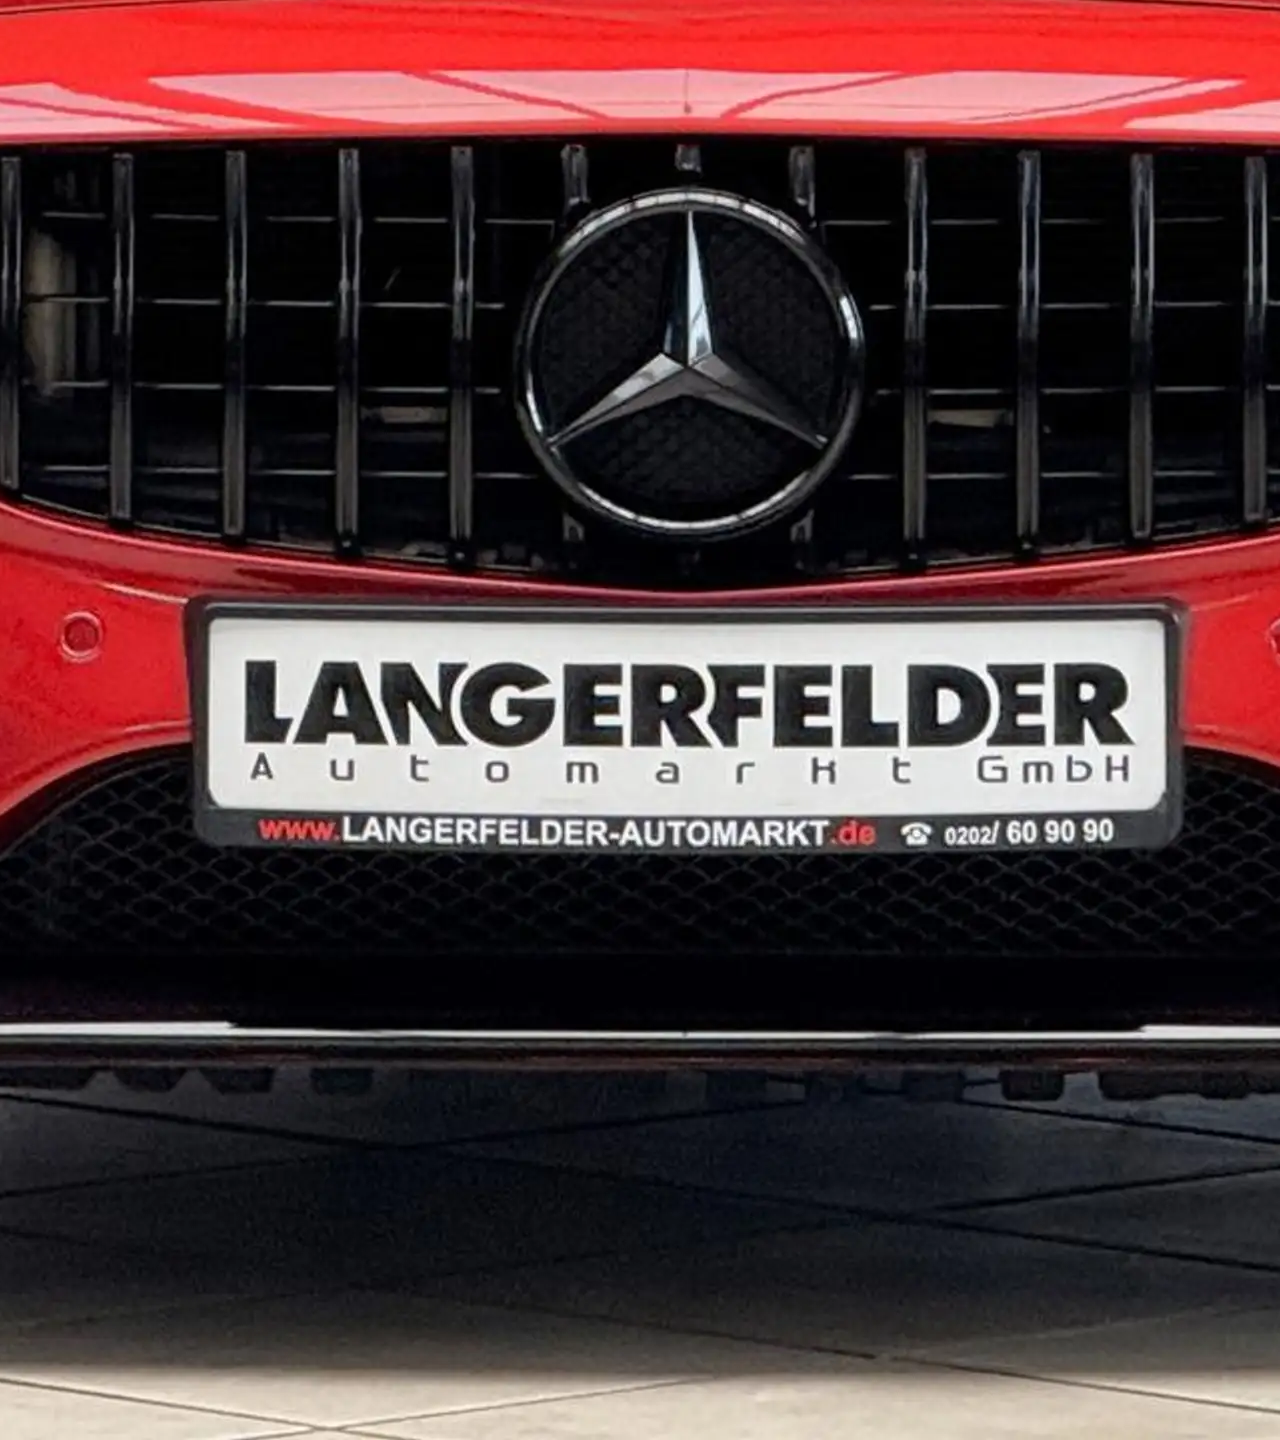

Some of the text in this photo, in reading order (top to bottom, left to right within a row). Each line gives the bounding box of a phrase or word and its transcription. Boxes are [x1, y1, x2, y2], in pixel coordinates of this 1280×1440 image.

[244, 661, 1135, 748] LANGERFELDER
[977, 755, 1129, 783] GmbH
[258, 815, 876, 846] www.LANGERFELDER-AUTOMARKT.de
[1006, 819, 1037, 845] 60
[1044, 818, 1075, 844] 90
[1082, 817, 1114, 843] 90
